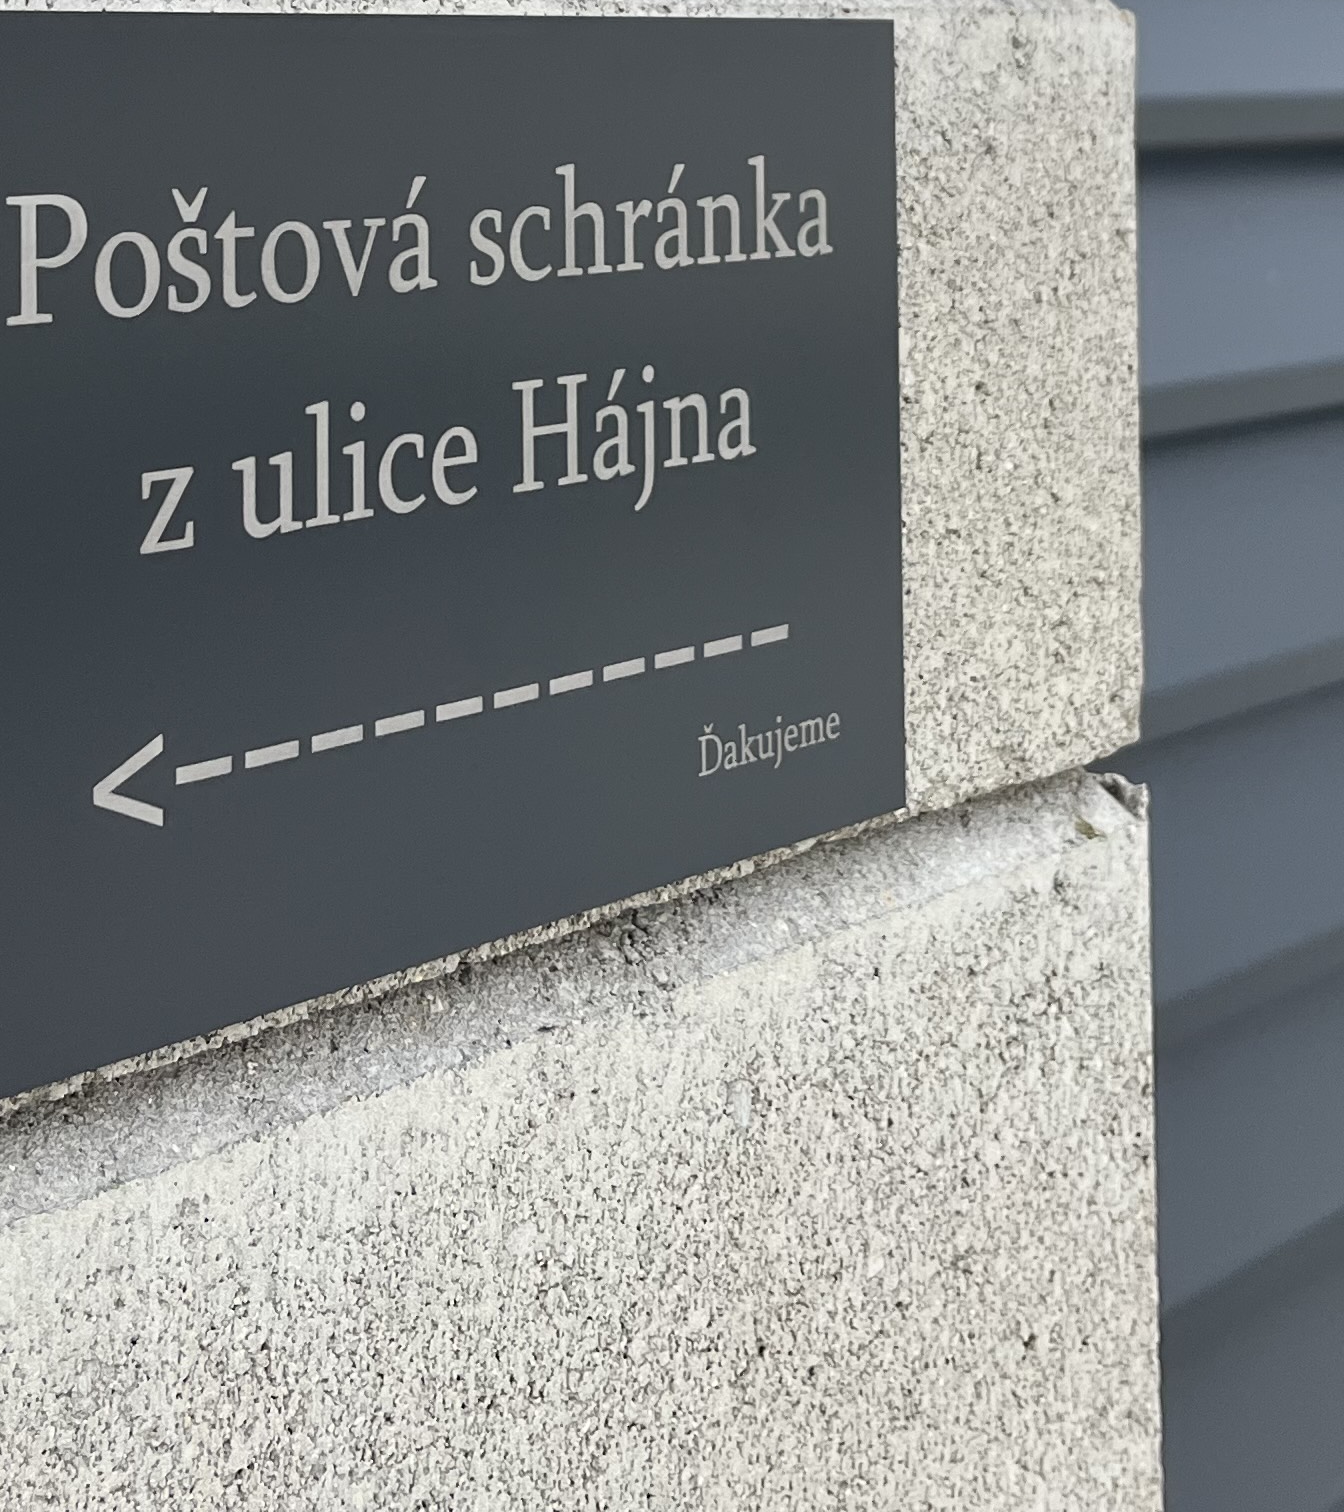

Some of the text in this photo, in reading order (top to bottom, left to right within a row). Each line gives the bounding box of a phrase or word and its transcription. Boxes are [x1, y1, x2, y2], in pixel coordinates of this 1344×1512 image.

[5, 154, 834, 327] Poštová schránka
[139, 364, 757, 555] z ulice Hájna
[697, 712, 841, 778] Ďakujeme
